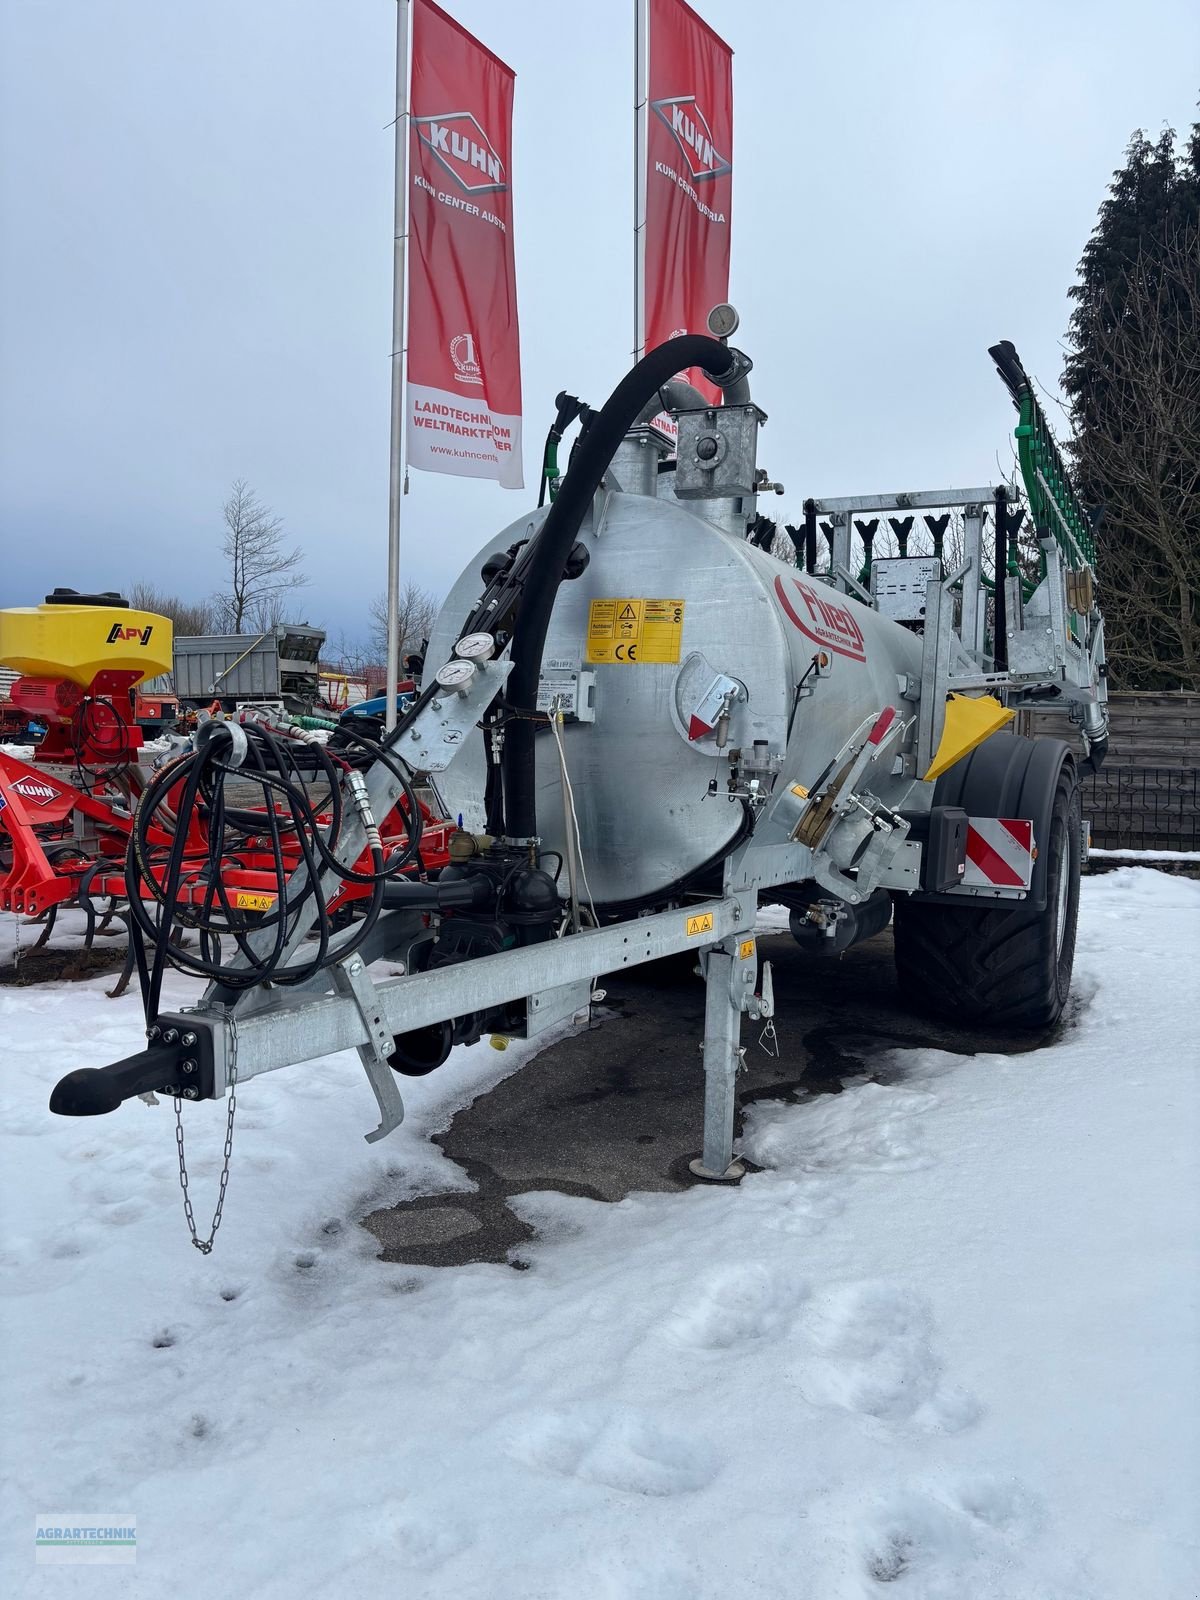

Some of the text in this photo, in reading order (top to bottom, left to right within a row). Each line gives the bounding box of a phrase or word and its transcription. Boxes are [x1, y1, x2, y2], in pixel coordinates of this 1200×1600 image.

[430, 121, 500, 183] KUHN
[672, 103, 713, 170] KUHN
[414, 175, 506, 233] KUHN CENTER AUSTR
[655, 161, 677, 182] KUHN
[697, 201, 726, 222] USTRIA
[415, 400, 492, 426] LANDTECHNI
[792, 578, 864, 652] Fliegl
[815, 626, 852, 647] AGRARTECHNIK
[615, 644, 638, 661] CE
[16, 784, 55, 798] KUHN
